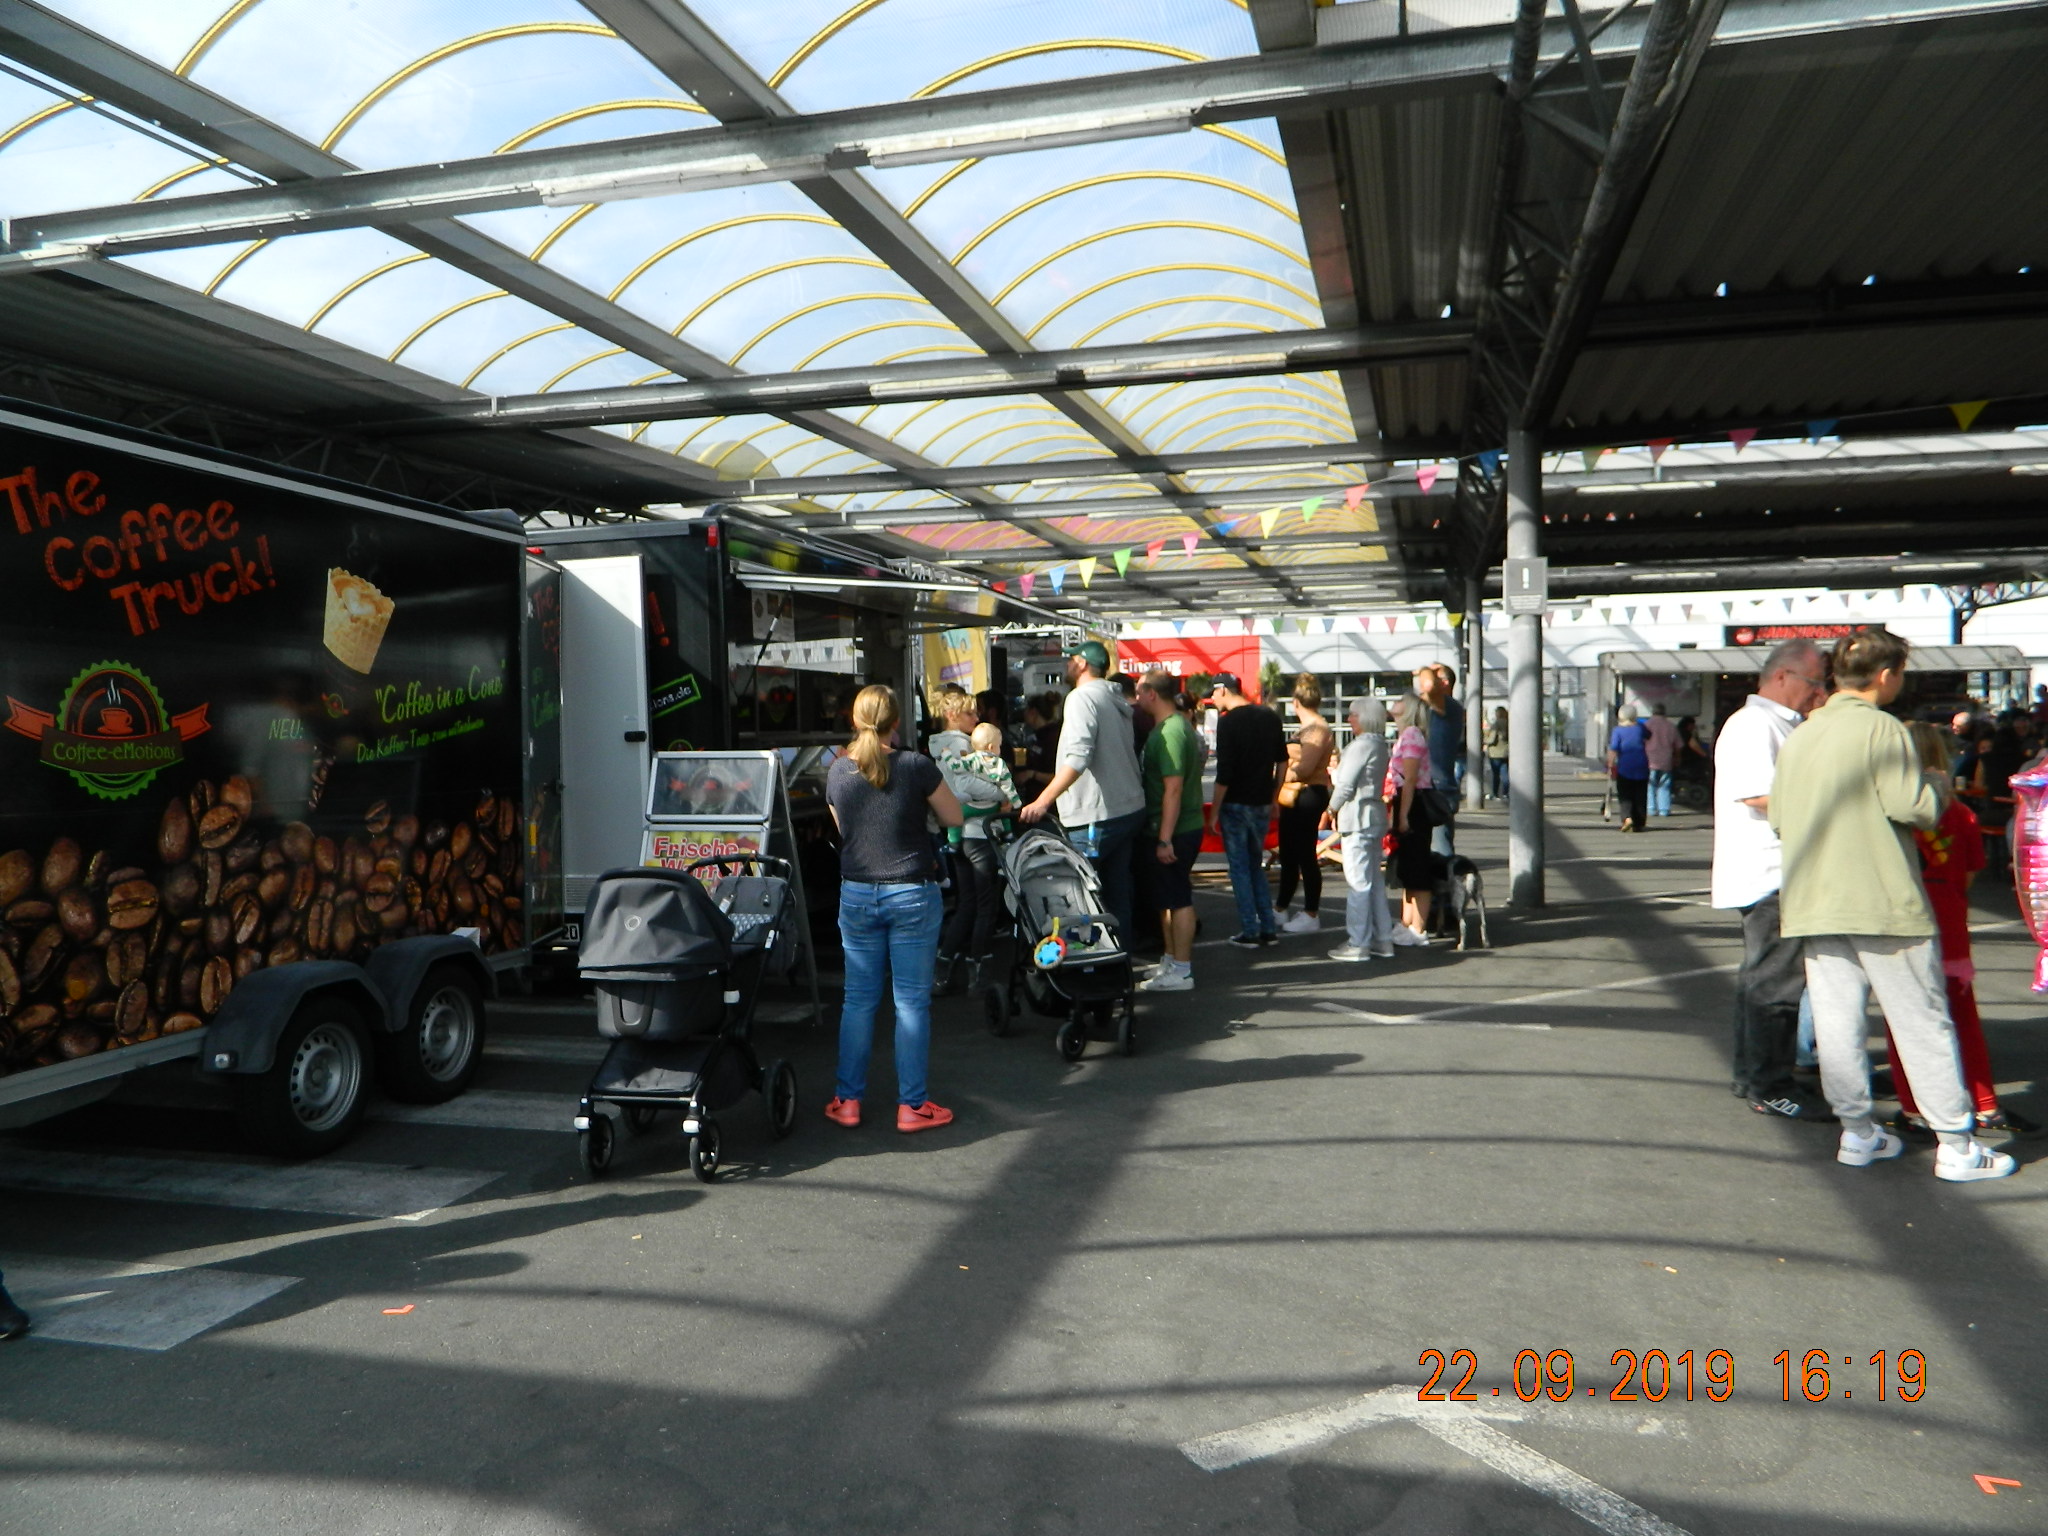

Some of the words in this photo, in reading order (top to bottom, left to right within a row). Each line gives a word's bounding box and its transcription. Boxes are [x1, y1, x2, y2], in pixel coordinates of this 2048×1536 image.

[0, 466, 106, 534] The
[44, 500, 239, 591] Coffee
[110, 534, 276, 636] Truck!
[1120, 658, 1182, 677] Eingang
[437, 686, 452, 710] in
[455, 687, 465, 706] a
[53, 741, 177, 764] Coffee-eMotions
[653, 836, 739, 857] Frische
